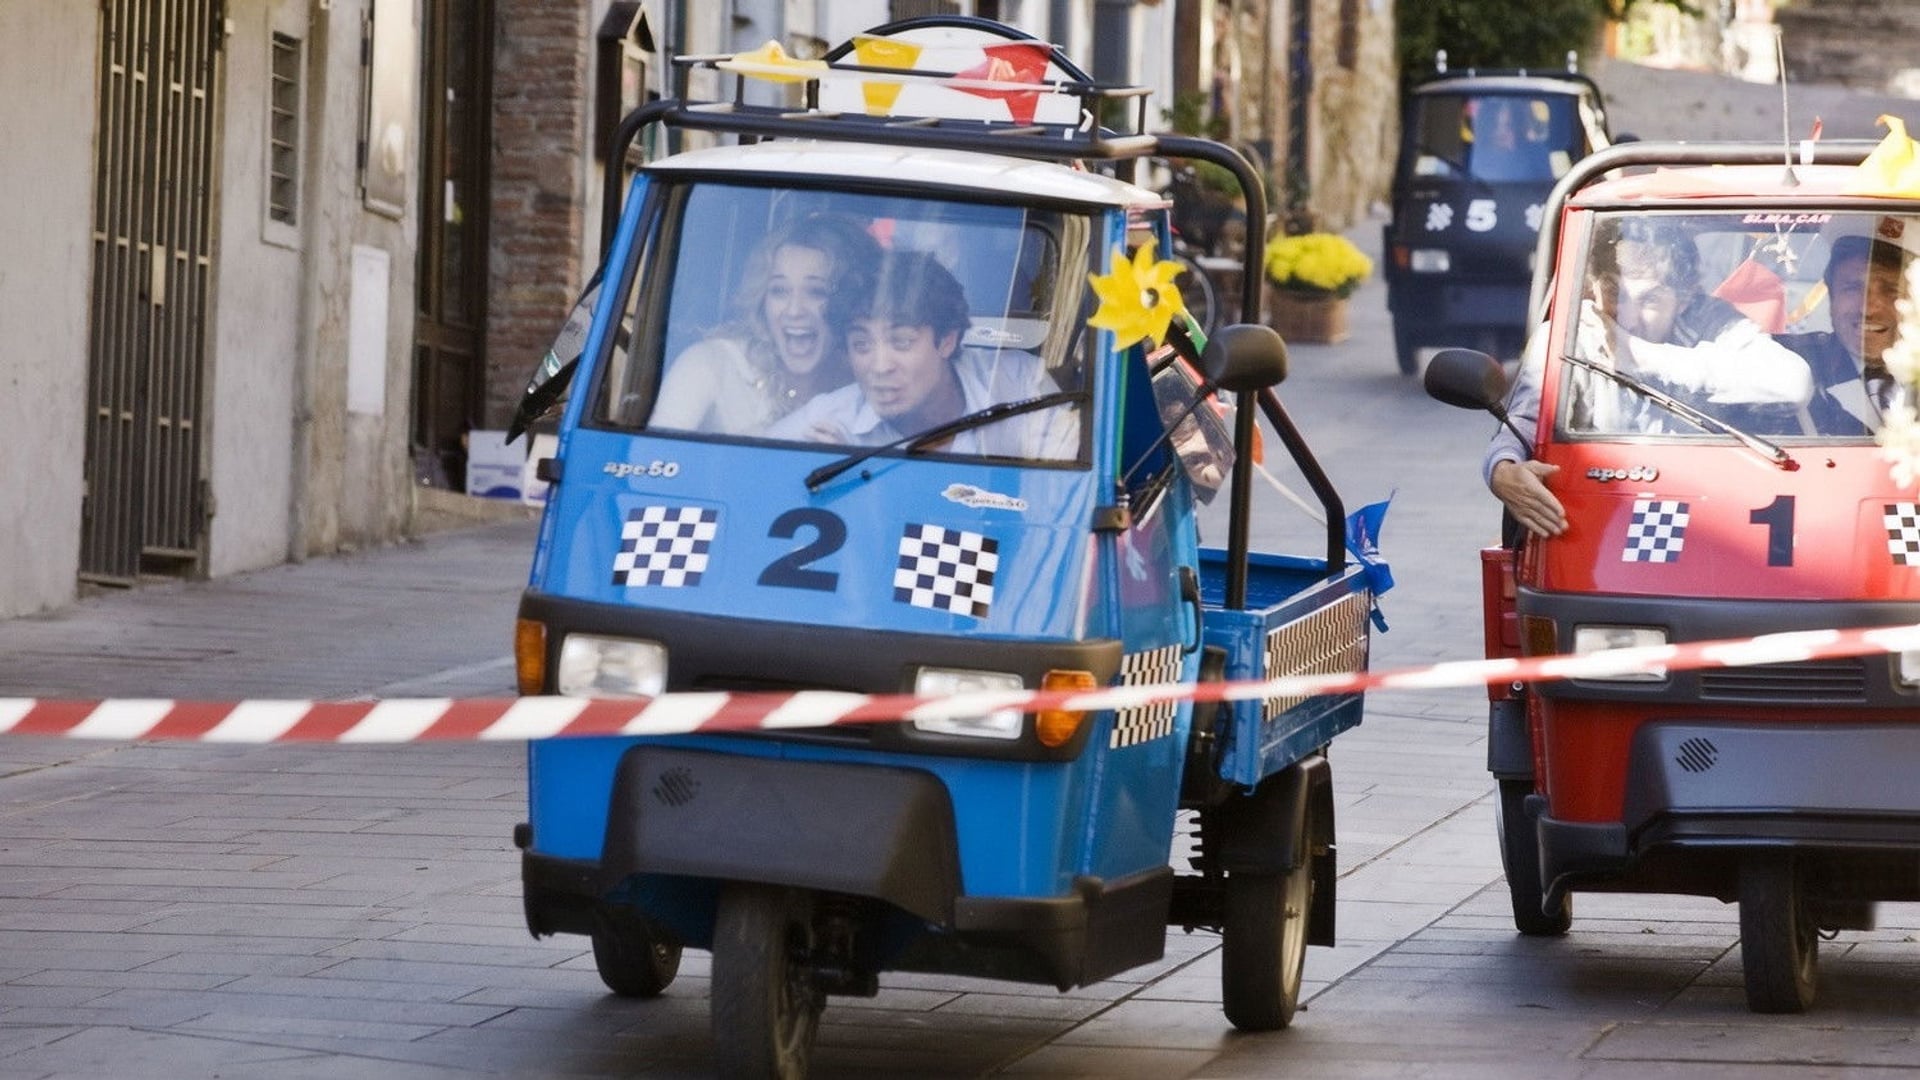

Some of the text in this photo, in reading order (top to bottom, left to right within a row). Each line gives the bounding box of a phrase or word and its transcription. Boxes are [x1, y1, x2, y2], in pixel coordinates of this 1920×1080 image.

[1465, 199, 1497, 232] 5
[757, 507, 847, 593] 2
[1749, 495, 1795, 567] 1
